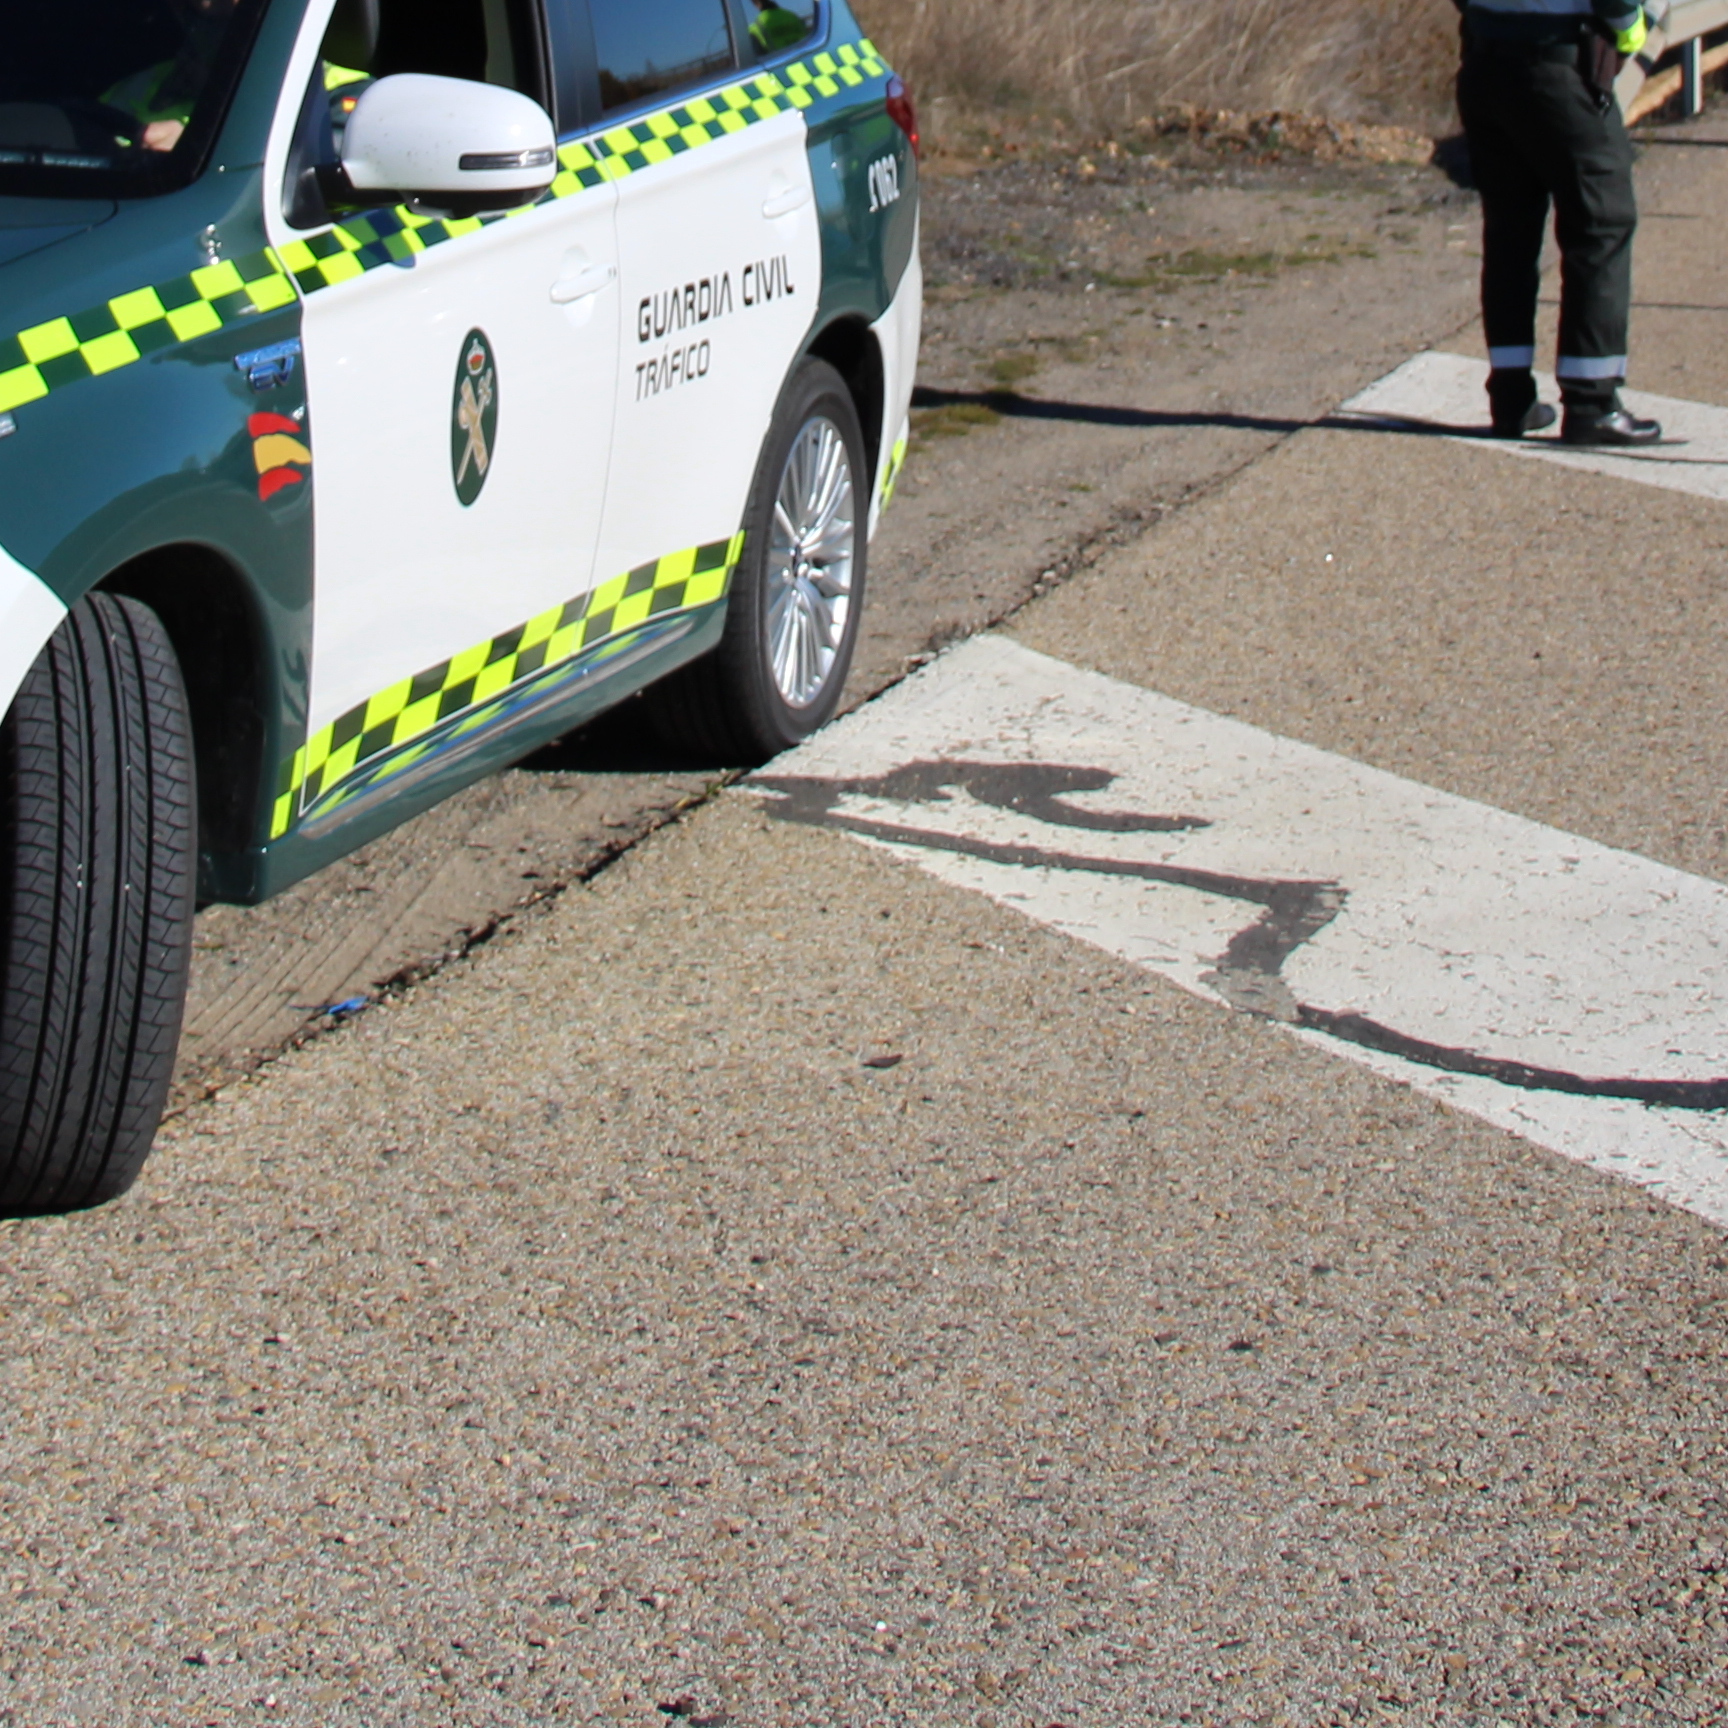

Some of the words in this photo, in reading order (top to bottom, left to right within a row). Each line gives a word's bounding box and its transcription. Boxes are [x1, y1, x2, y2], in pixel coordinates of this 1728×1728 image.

[638, 270, 733, 344] GUARDIA
[742, 254, 794, 307] CIVIL
[635, 338, 710, 402] TRÁFICO
